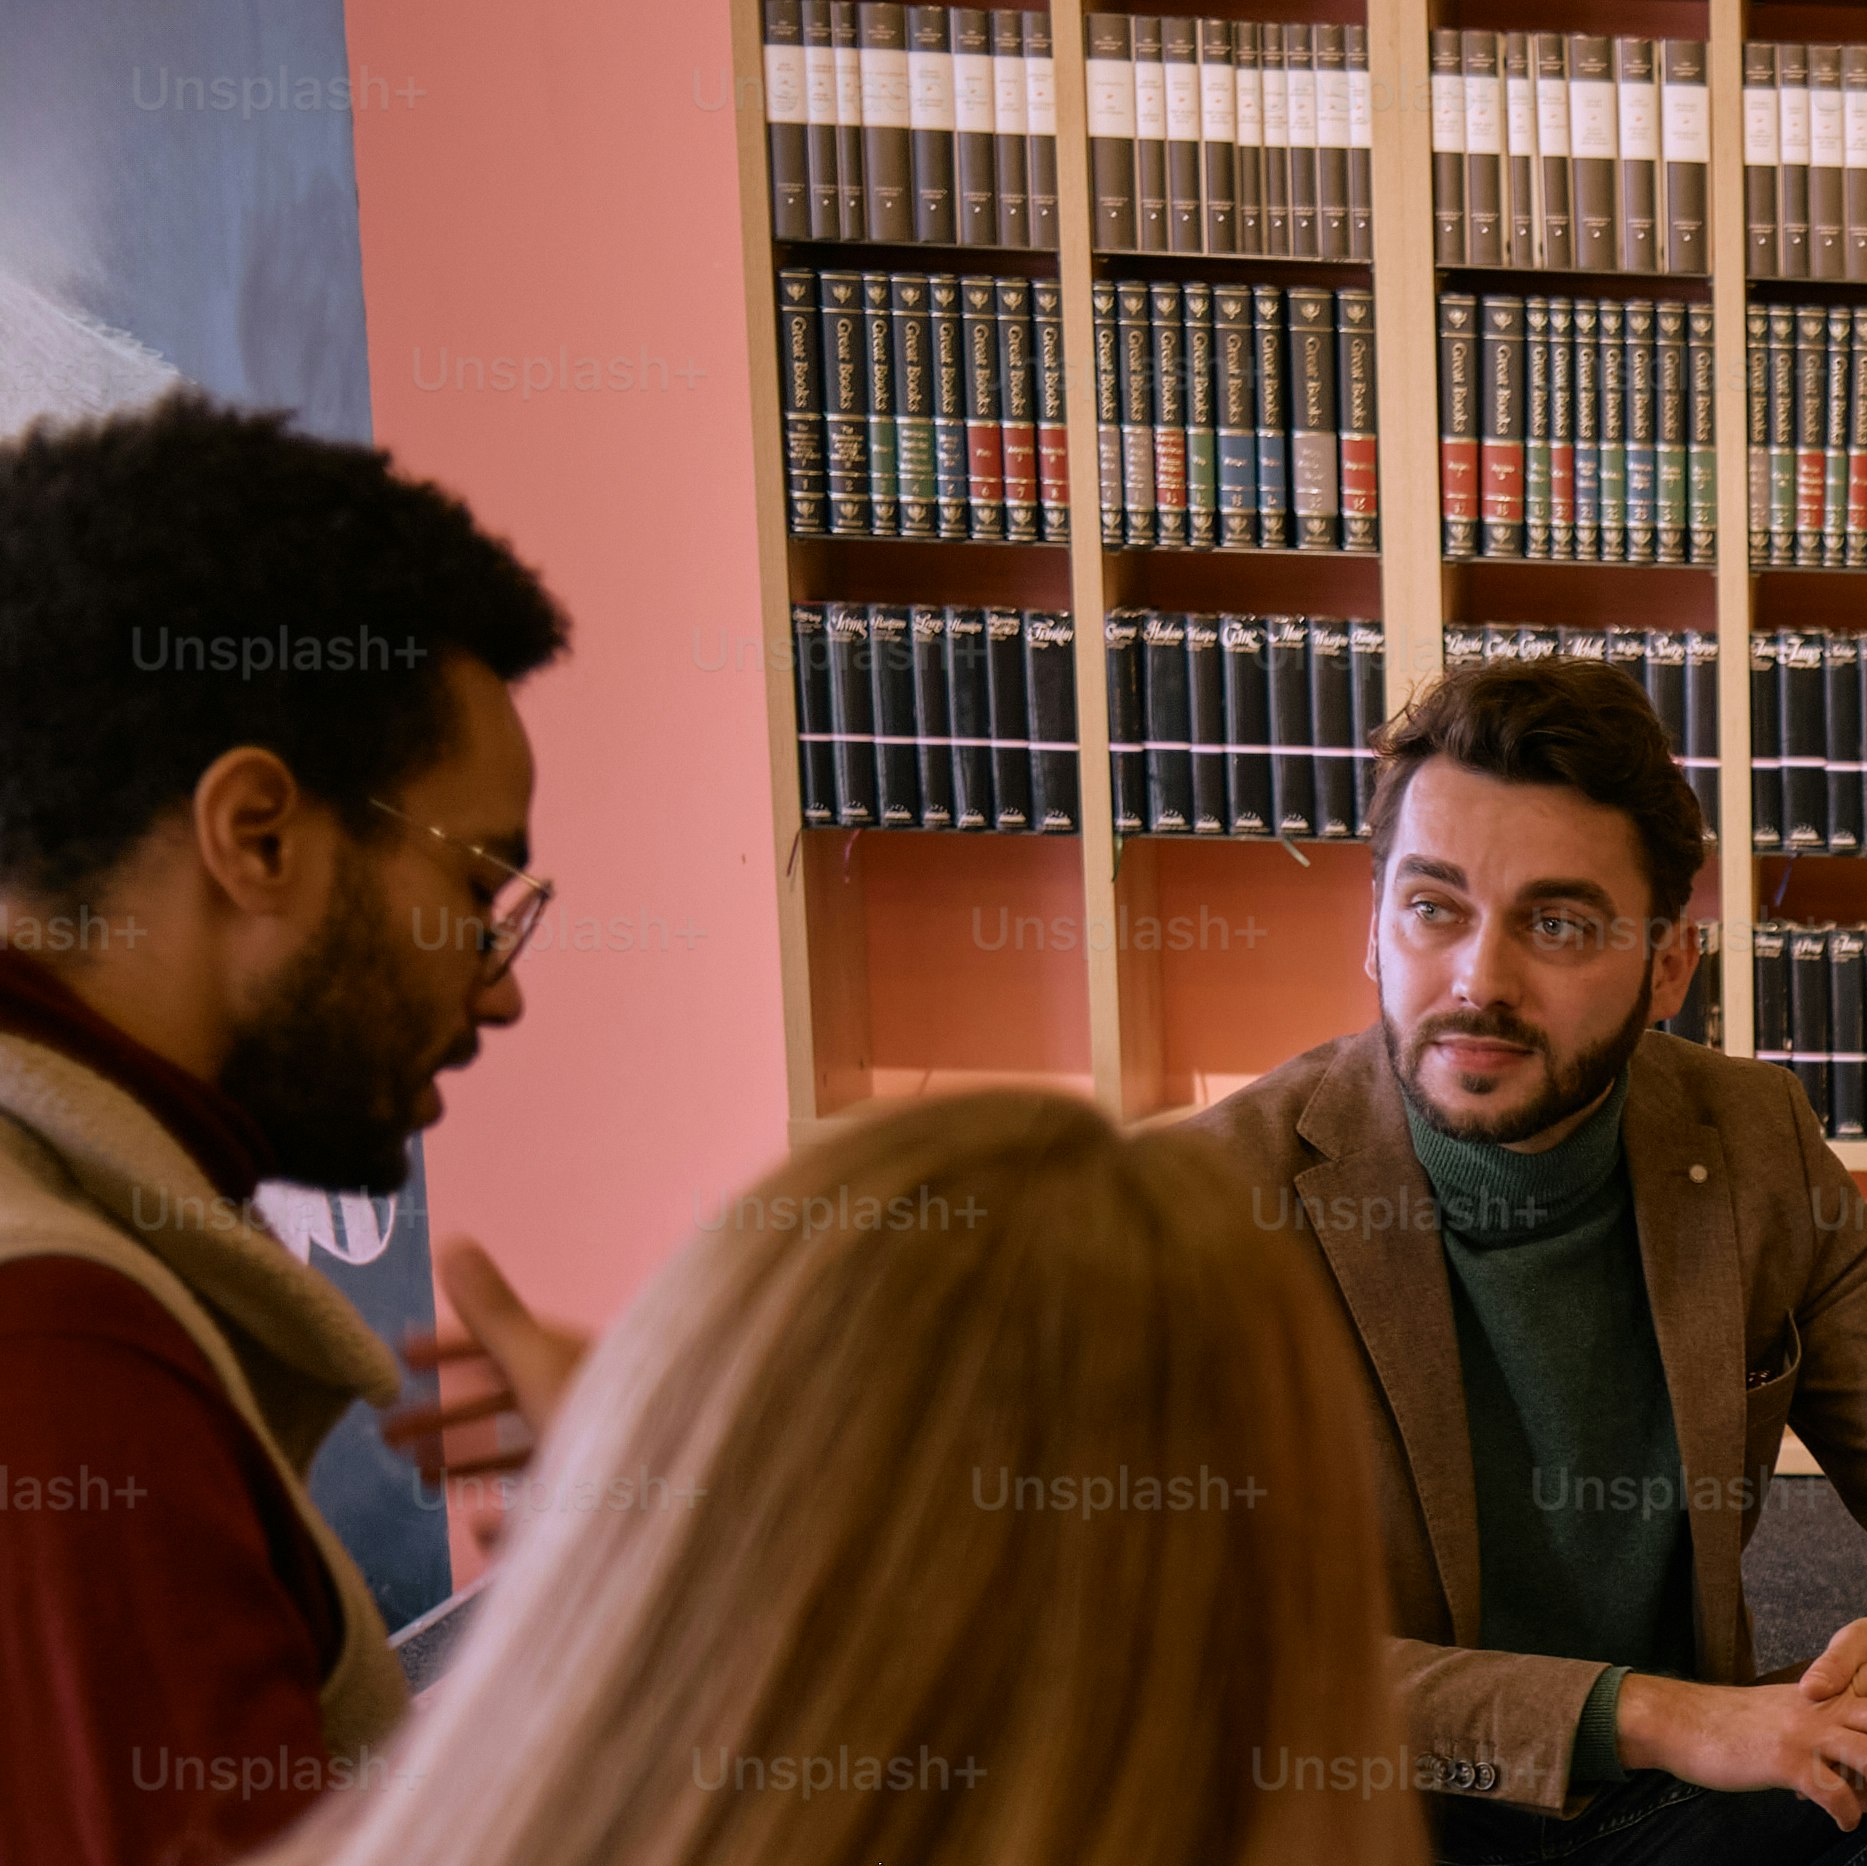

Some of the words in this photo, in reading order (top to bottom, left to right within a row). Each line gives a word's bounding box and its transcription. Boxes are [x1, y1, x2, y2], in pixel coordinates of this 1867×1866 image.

[791, 317, 806, 359] Great
[837, 318, 852, 361] Great
[873, 320, 887, 362] Great
[906, 321, 920, 363] Great
[940, 322, 954, 365] Great
[974, 324, 989, 366] Great
[1008, 326, 1023, 368] Great
[1044, 327, 1058, 368] Great
[1100, 330, 1113, 370] Great
[1129, 330, 1143, 372] Great
[1161, 330, 1176, 372] Great
[1194, 331, 1208, 374] Great
[1227, 334, 1241, 374] Great
[1264, 334, 1278, 376] Great
[1306, 336, 1320, 376] Great
[1351, 339, 1366, 379] Great
[1452, 342, 1467, 383] Great
[1496, 345, 1511, 385] Great
[1533, 346, 1547, 388] Great
[1555, 347, 1570, 388] Great
[1580, 348, 1594, 388] Great
[1606, 349, 1620, 389] Great
[1634, 350, 1648, 389] Great
[1664, 351, 1678, 390] Great
[1696, 351, 1710, 390] Great
[793, 362, 810, 408] Books
[839, 364, 854, 410] Books
[875, 365, 889, 410] Books
[907, 366, 922, 412] Books
[941, 368, 955, 414] Books
[976, 370, 990, 415] Books
[1010, 370, 1026, 416] Books
[1045, 372, 1060, 417] Books
[1101, 374, 1116, 420] Books
[1130, 375, 1144, 420] Books
[1162, 376, 1177, 421] Books
[1194, 377, 1209, 422] Books
[1228, 379, 1242, 424] Books
[1264, 379, 1279, 424] Books
[1308, 381, 1322, 426] Books
[1352, 382, 1367, 428] Books
[1453, 387, 1468, 432] Books
[1496, 388, 1511, 434] Books
[1534, 390, 1548, 436] Books
[1555, 391, 1570, 436] Books
[1580, 392, 1594, 437] Books
[1606, 392, 1621, 438] Books
[1634, 393, 1649, 438] Books
[1664, 395, 1679, 440] Books
[1696, 396, 1711, 440] Books
